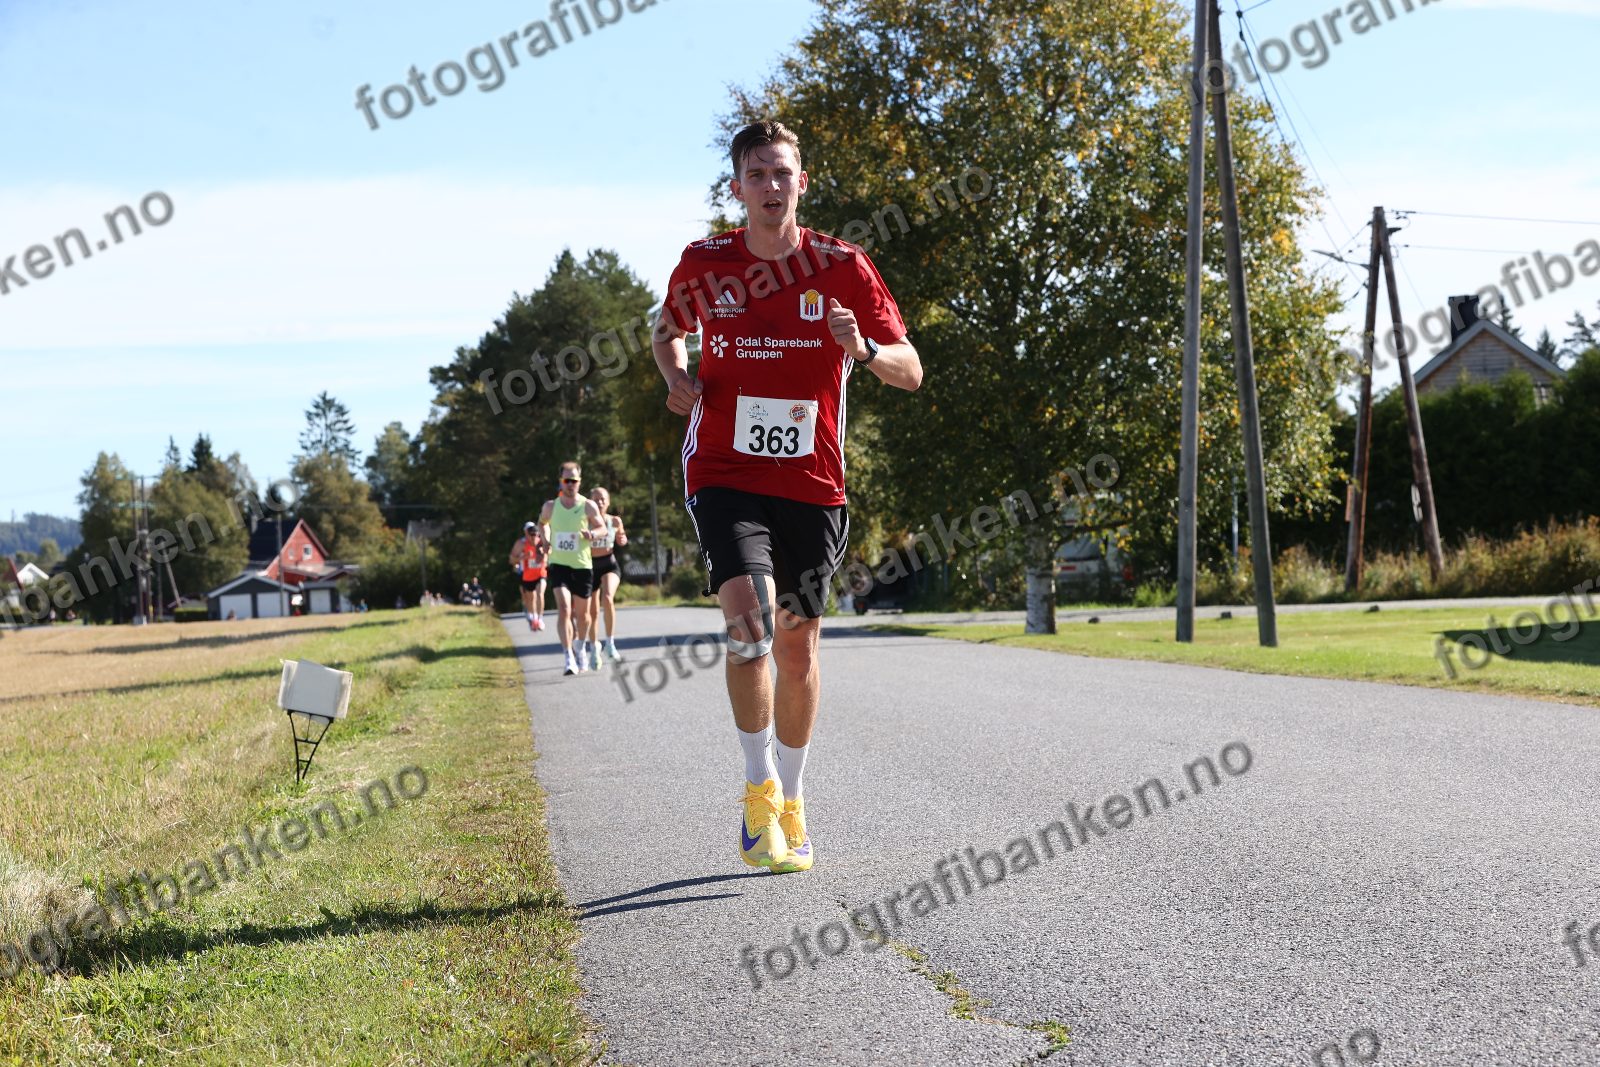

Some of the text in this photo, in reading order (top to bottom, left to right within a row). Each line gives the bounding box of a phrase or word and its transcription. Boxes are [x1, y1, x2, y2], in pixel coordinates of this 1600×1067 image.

[735, 336, 823, 349] Odal Sparebank
[735, 348, 783, 360] Gruppen
[748, 424, 800, 456] 363
[558, 541, 575, 550] 406
